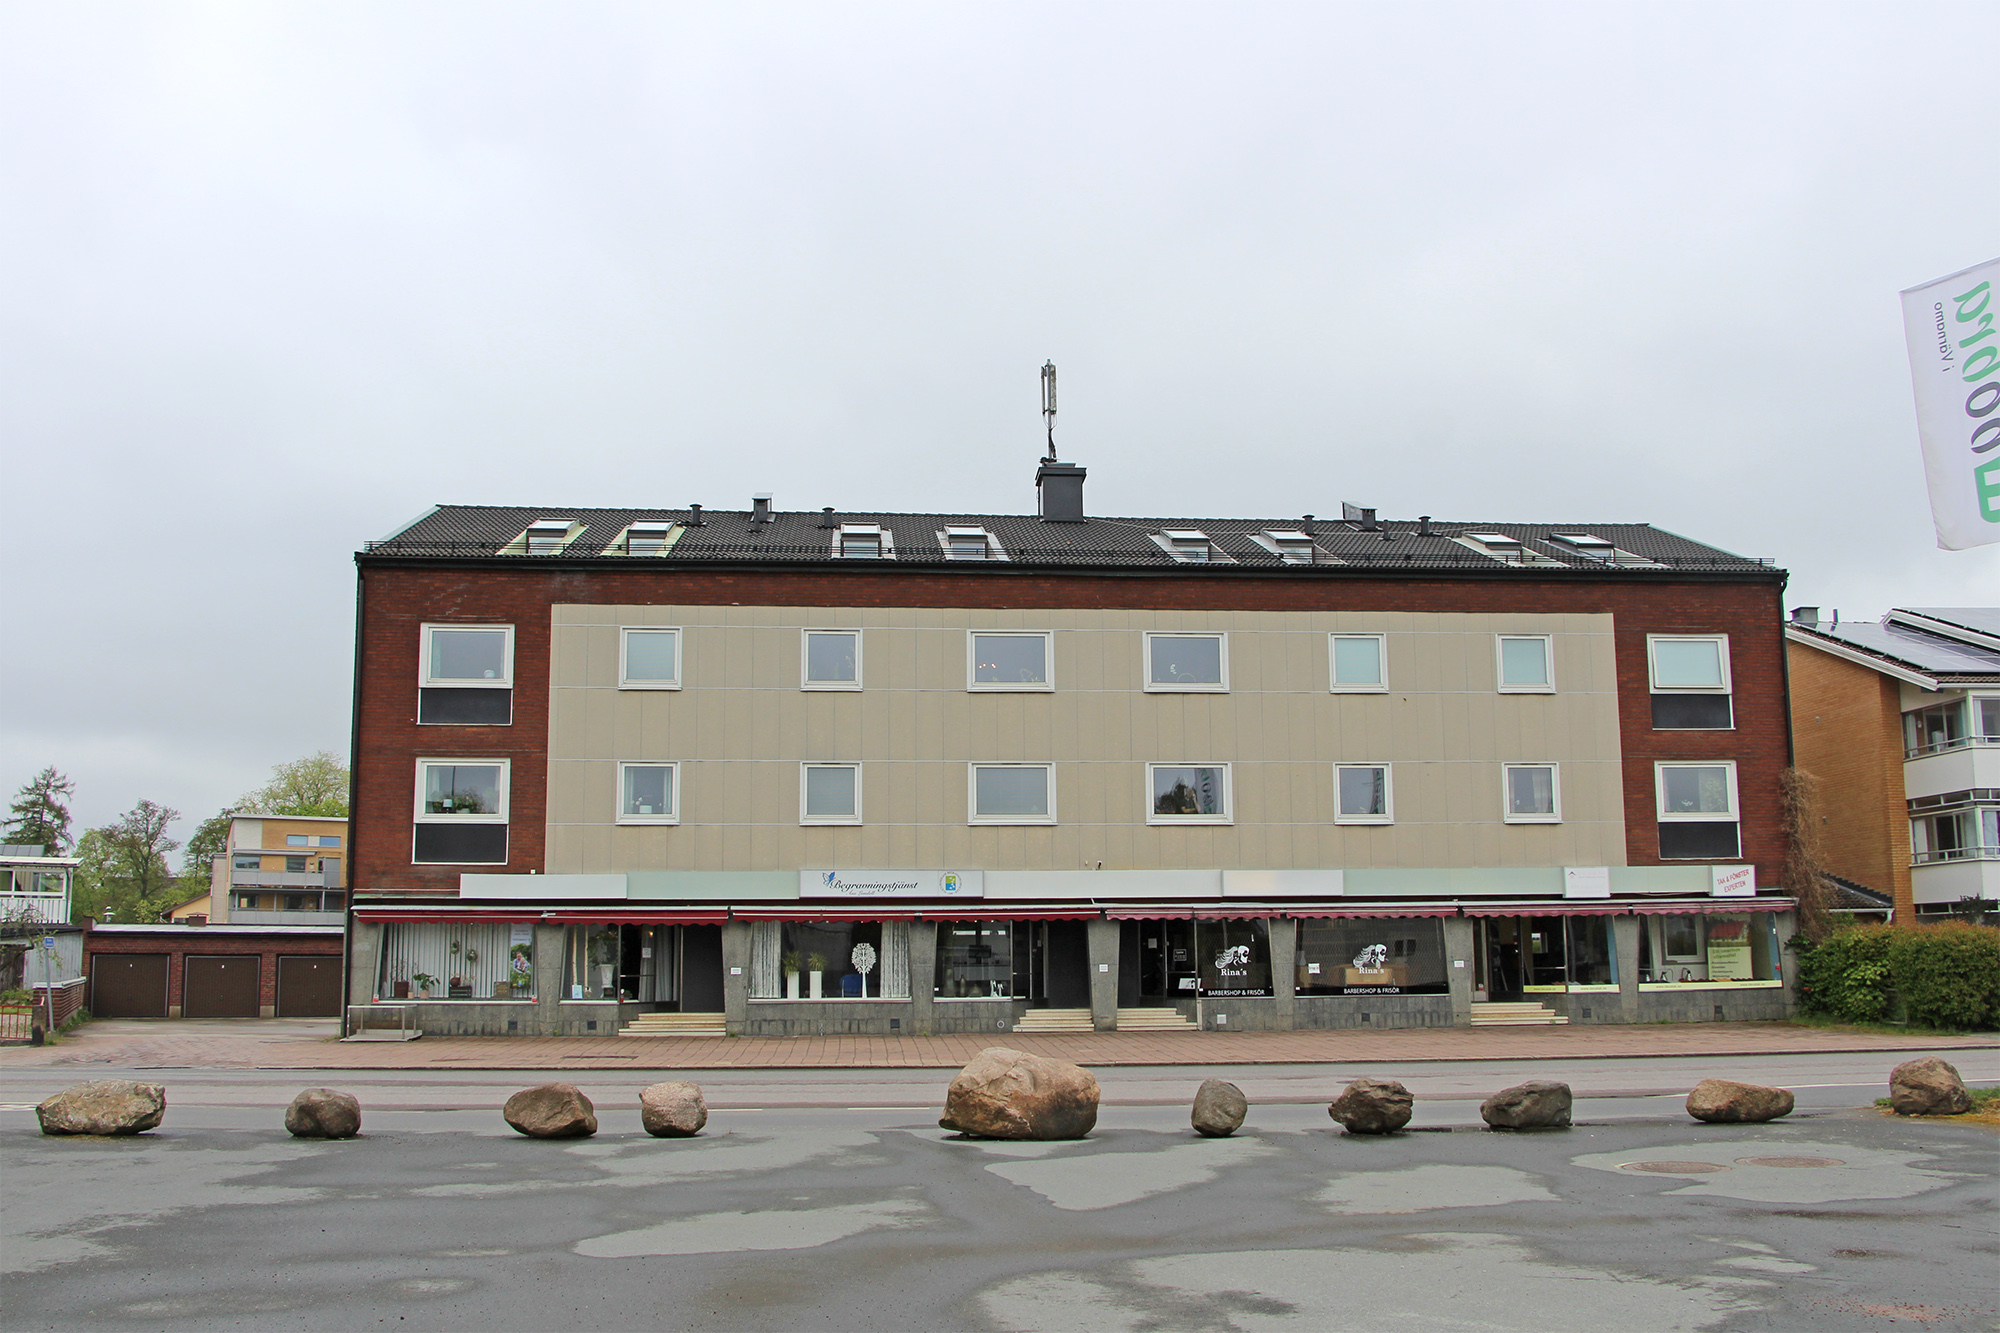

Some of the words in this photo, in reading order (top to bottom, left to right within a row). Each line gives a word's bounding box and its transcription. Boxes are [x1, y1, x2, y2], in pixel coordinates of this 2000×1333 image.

[1730, 868, 1749, 881] FÖNSTER
[829, 879, 919, 893] Begravningstjänst
[1723, 880, 1746, 893] EXPERTEN
[1247, 988, 1265, 996] FRISÖR
[1343, 987, 1376, 995] BARBERSHOP
[1382, 986, 1400, 994] FRISÖR
